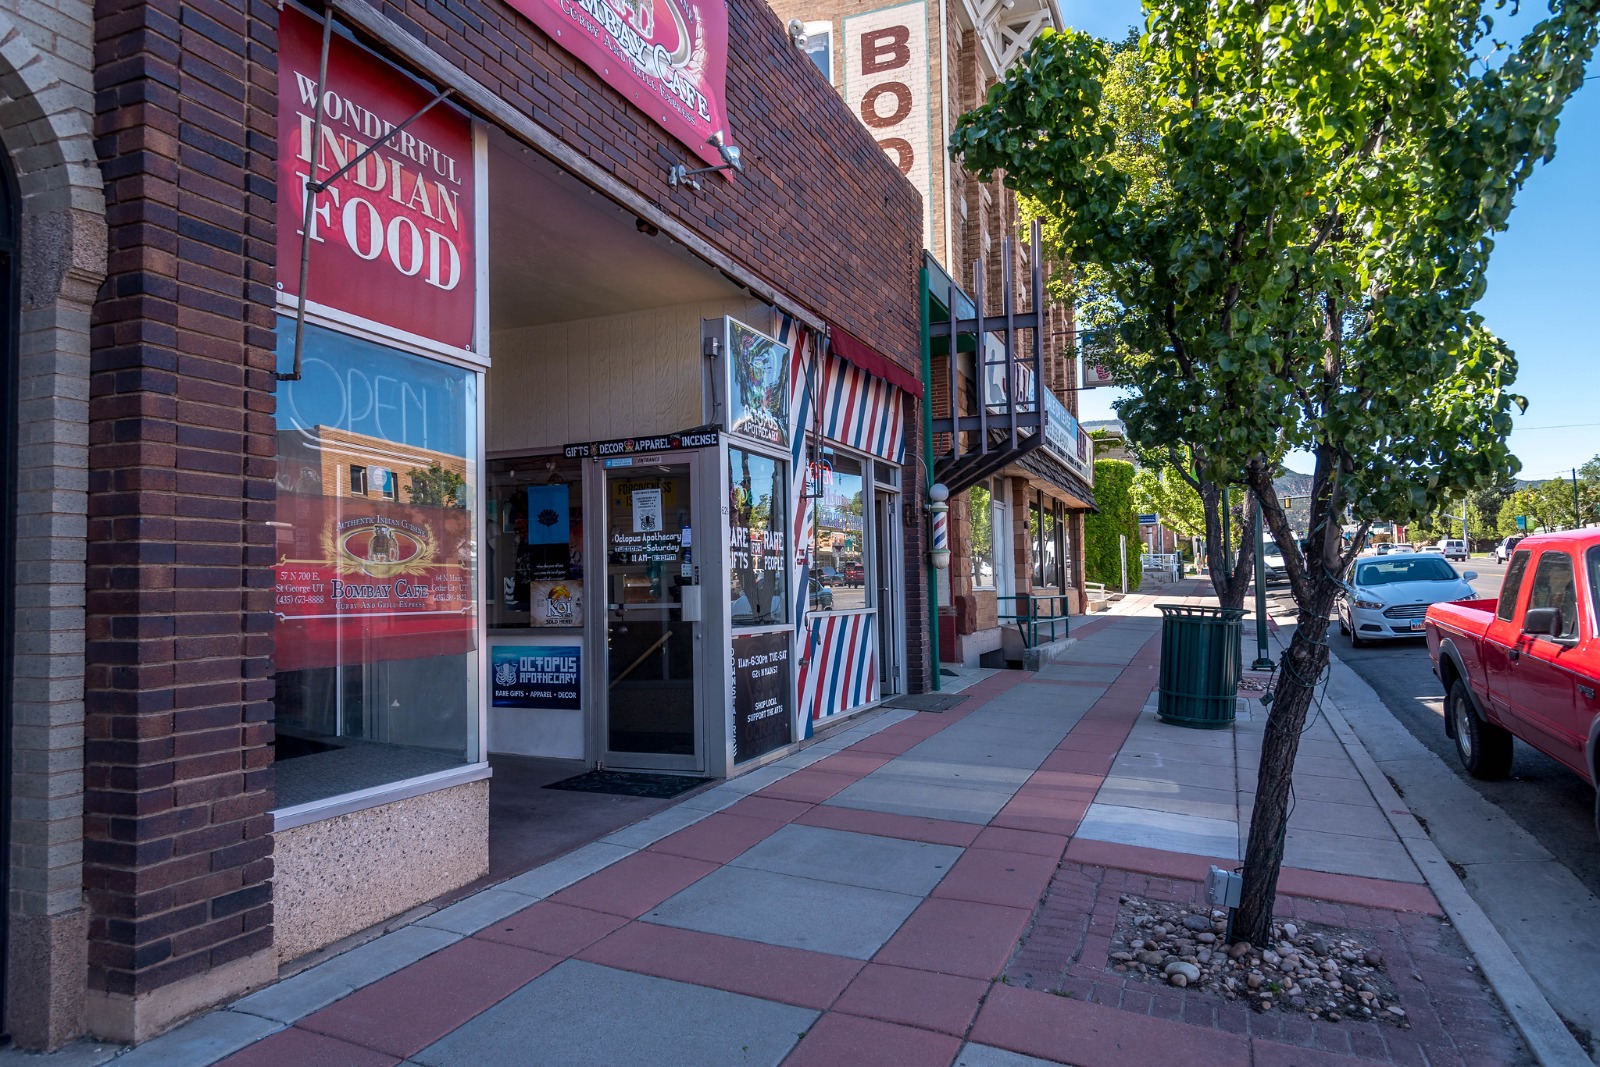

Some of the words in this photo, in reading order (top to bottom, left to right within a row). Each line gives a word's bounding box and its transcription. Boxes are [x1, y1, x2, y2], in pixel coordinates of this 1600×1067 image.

[628, 55, 658, 91] GRILL
[653, 43, 712, 123] CAFE
[293, 70, 462, 186] WONDERFUL
[295, 111, 460, 232] INDIAN
[295, 170, 461, 291] FOOD
[287, 357, 428, 450] OPEN
[744, 403, 779, 431] OCTOPUS
[743, 419, 780, 442] APOTHECARY
[565, 445, 589, 458] GIFTS
[599, 441, 624, 454] DECOR
[634, 437, 671, 451] APPAREL
[681, 433, 717, 448] INCENSE
[637, 456, 661, 464] ENTRANCE
[336, 517, 374, 531] AUTHENTIC
[377, 514, 400, 527] INDIAN
[401, 519, 427, 537] CUISINE
[614, 533, 641, 544] Octopus
[642, 531, 682, 543] Apothecary
[730, 550, 749, 569] IFTS
[764, 555, 784, 571] PEOPLE
[280, 571, 288, 581] 57
[290, 571, 297, 581] N
[299, 571, 311, 581] 700
[276, 583, 284, 593] St
[285, 583, 311, 594] George
[312, 583, 325, 592] UT
[331, 579, 392, 600] BOMBAY
[395, 579, 428, 599] CAFE
[431, 583, 447, 592] Cedar
[276, 595, 294, 605] (435)
[336, 601, 358, 611] CURRY
[361, 601, 376, 610] AND
[378, 600, 396, 610] GRILL
[399, 600, 426, 609] EXPRESS
[519, 656, 577, 672] OCTOPUS
[519, 672, 577, 684] APOTHECARY
[509, 690, 525, 698] GIFTS
[557, 691, 577, 699] DECOR
[754, 700, 766, 711] SHOP
[766, 697, 777, 707] LOCAL
[747, 710, 766, 723] SUPPORT
[766, 707, 774, 717] THE
[774, 704, 783, 714] ARTS
